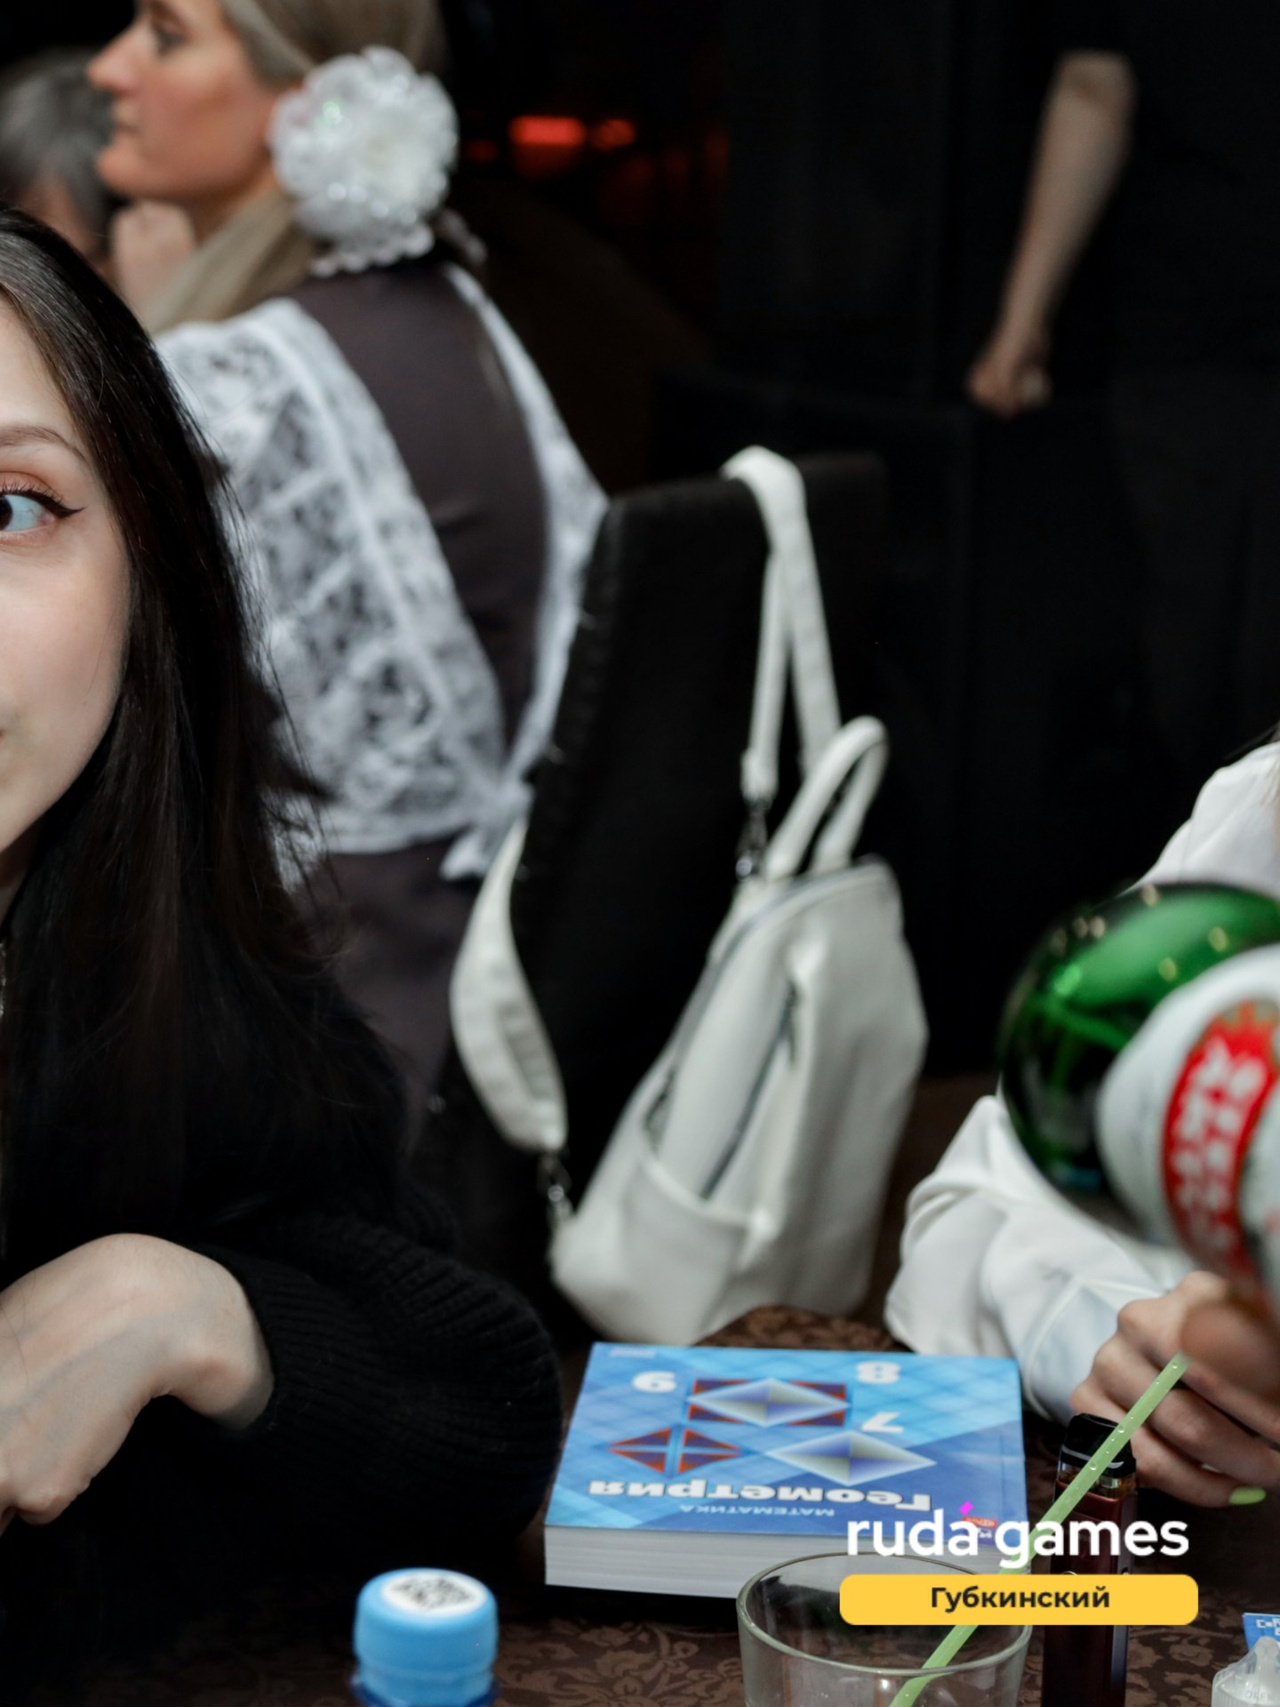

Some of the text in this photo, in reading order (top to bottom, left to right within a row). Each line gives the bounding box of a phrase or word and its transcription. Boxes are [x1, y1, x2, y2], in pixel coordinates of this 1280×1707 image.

[632, 1371, 677, 1393] 9
[856, 1361, 901, 1384] 8
[861, 1412, 904, 1434] 7
[589, 1479, 931, 1511] Геометрия
[679, 1503, 835, 1518] МАТЕМАТИКА
